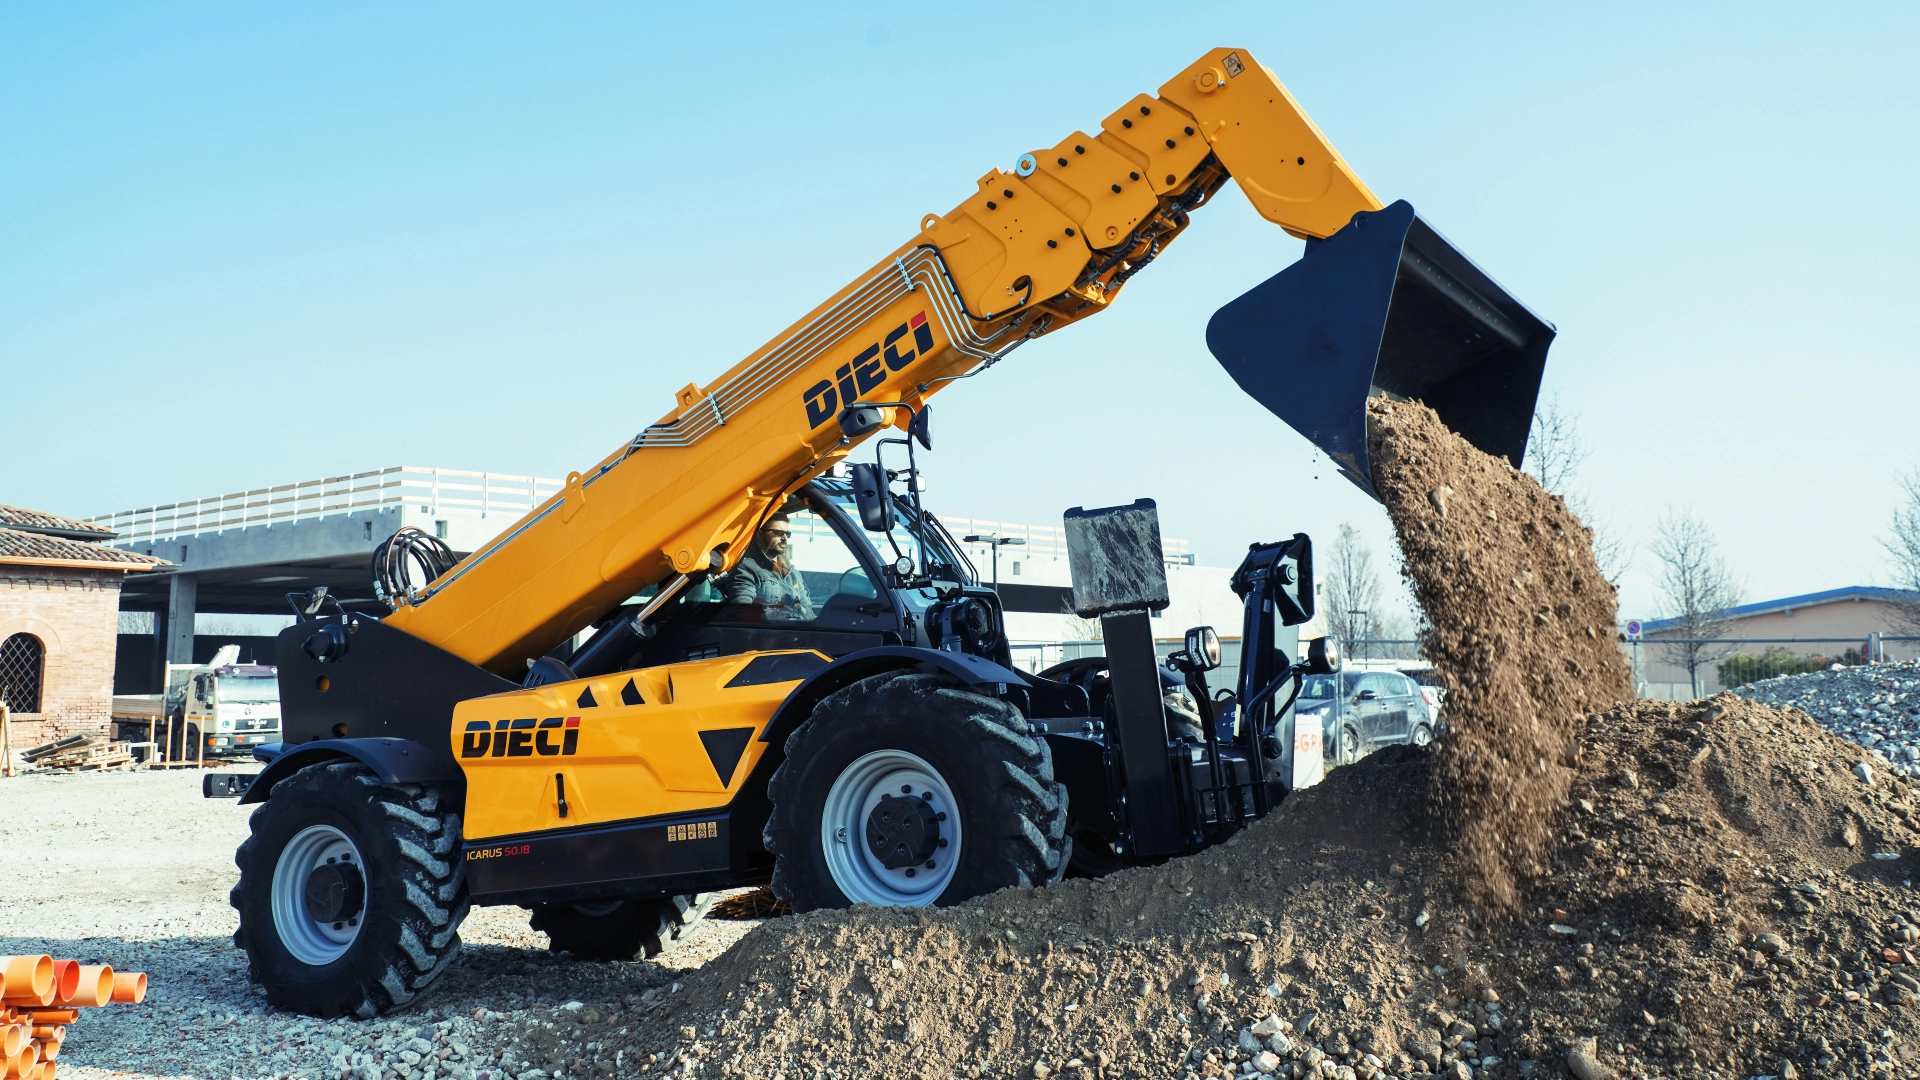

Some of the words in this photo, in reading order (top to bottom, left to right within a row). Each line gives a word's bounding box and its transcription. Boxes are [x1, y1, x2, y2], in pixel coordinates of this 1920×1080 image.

[803, 310, 934, 430] DIECI
[461, 717, 580, 758] DIECI
[466, 848, 502, 860] ICARUS
[504, 844, 530, 856] 50.18
